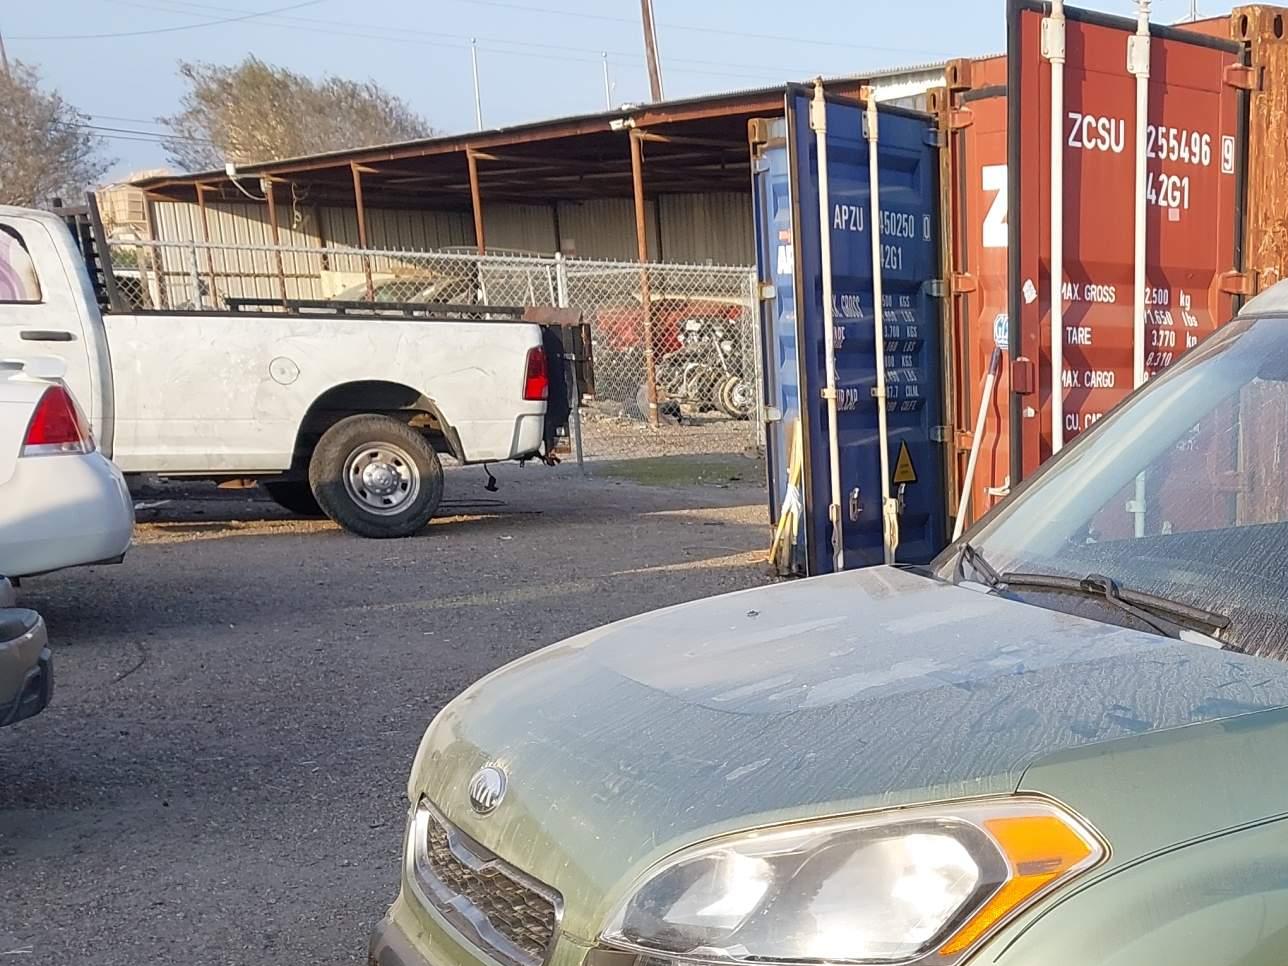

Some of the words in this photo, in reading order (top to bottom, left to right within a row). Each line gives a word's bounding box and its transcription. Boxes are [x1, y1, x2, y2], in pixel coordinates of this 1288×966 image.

[1068, 112, 1125, 152] ZCSU
[1147, 124, 1211, 166] 255496
[1223, 137, 1234, 172] 9
[1147, 172, 1189, 209] 42G1
[834, 204, 864, 232] APZU
[1084, 284, 1116, 303] GROSS
[1180, 289, 1191, 311] kg
[1181, 310, 1199, 327] lbs
[1066, 326, 1092, 345] TARE
[1151, 330, 1176, 348] 3.770
[1084, 370, 1115, 388] CARGO
[1065, 414, 1081, 431] CU.
